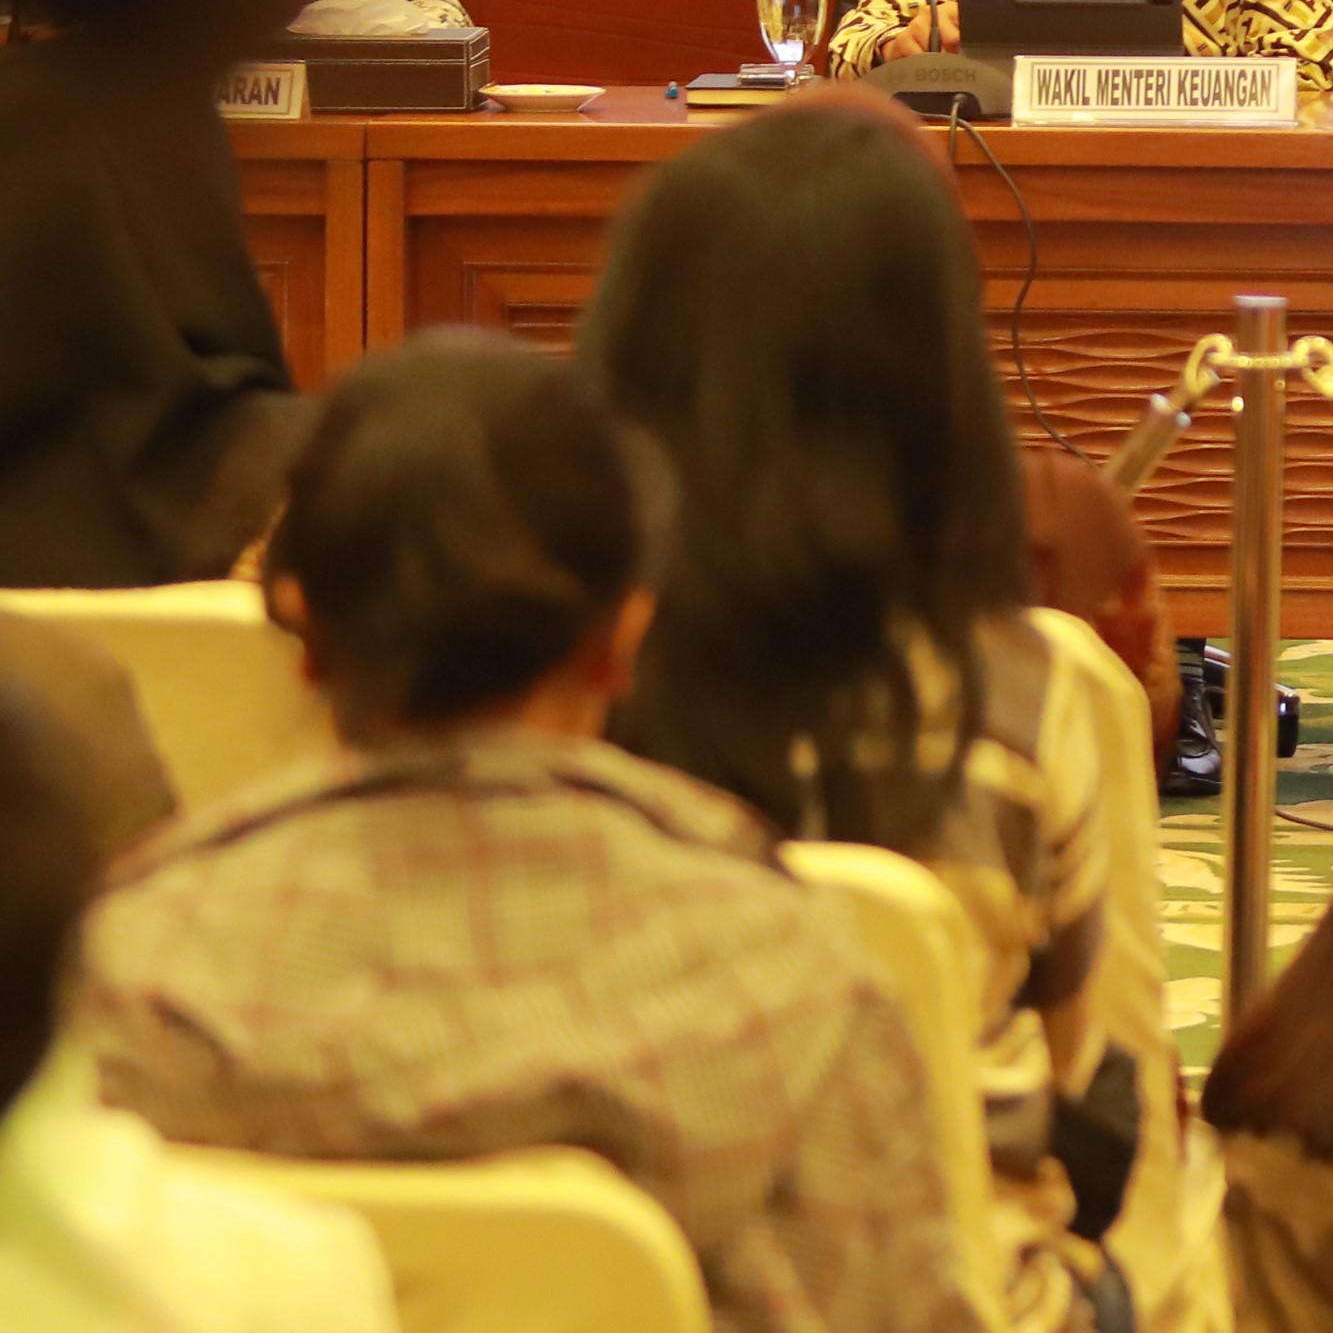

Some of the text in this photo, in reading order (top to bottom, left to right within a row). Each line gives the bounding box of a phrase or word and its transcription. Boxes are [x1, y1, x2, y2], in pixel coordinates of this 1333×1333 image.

[915, 68, 977, 83] BOSCH
[1037, 68, 1272, 107] WAKIL MENTERI KEUANGAN
